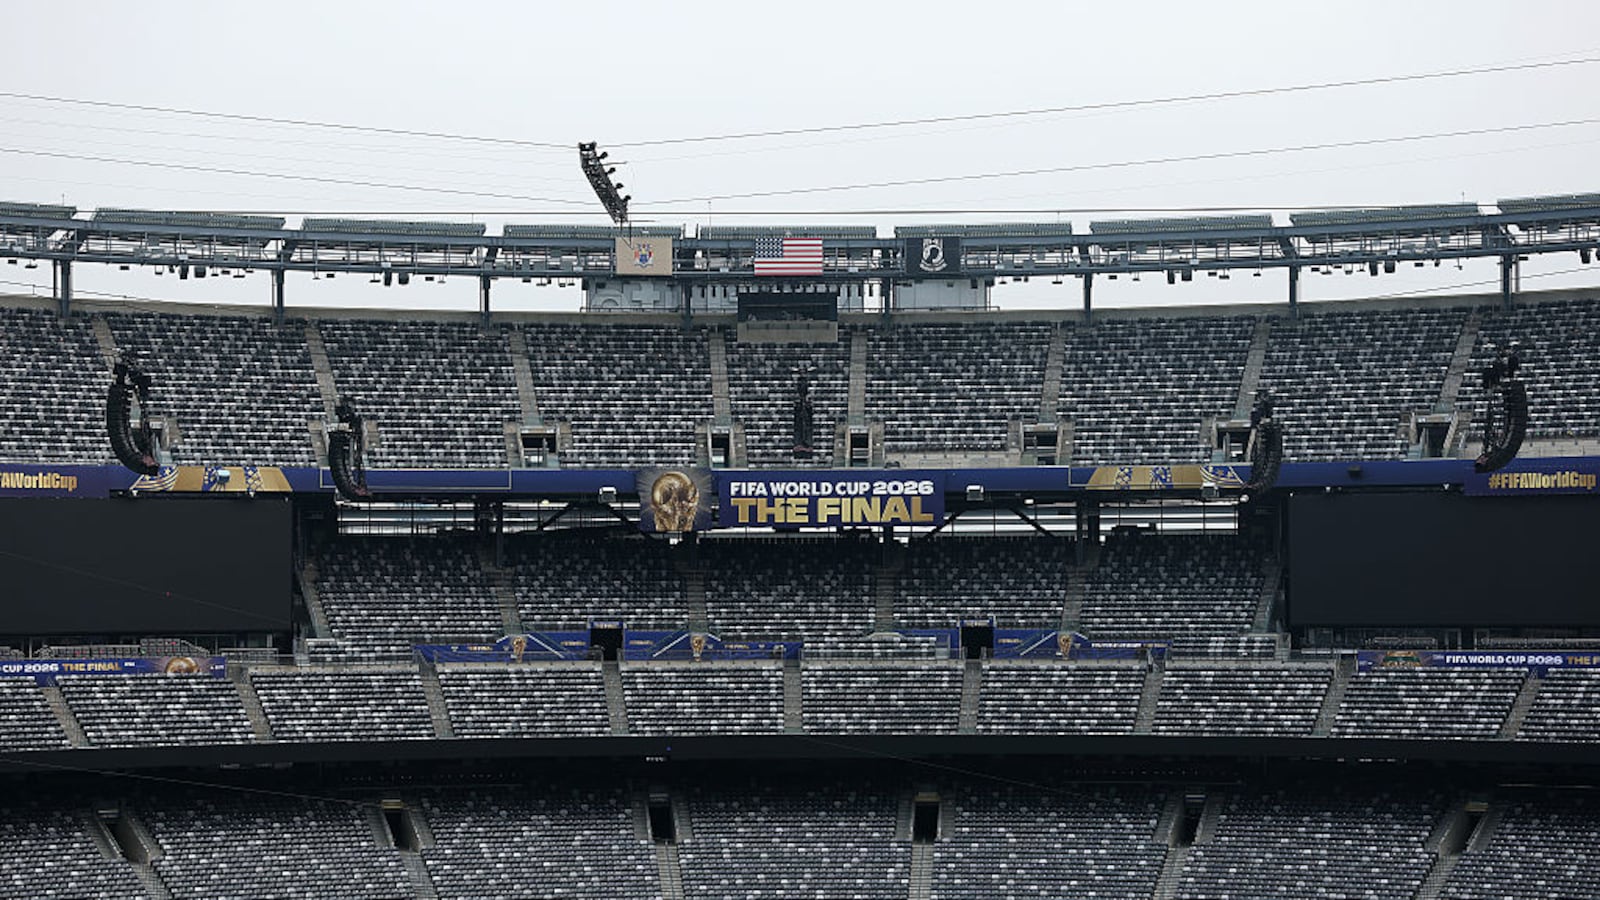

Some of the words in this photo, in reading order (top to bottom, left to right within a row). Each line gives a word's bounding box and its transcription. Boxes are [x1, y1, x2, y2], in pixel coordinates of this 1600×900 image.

[0, 472, 77, 492] AWorldCup
[730, 482, 768, 496] FIFA
[769, 482, 833, 496] WORLD
[835, 481, 871, 495] CUP
[872, 480, 935, 495] 2026
[1488, 471, 1596, 490] #FIFAWorldCup
[730, 497, 809, 523] THE
[817, 496, 934, 523] FINAL
[2, 664, 23, 673] CUP
[24, 663, 59, 673] 2026
[62, 663, 86, 672] THE
[87, 662, 122, 671] FINAL
[1446, 655, 1467, 664] FIFA
[1468, 655, 1504, 664] WORLD
[1505, 655, 1526, 664] CUP
[1527, 655, 1563, 665] 2026
[1567, 656, 1592, 665] THE
